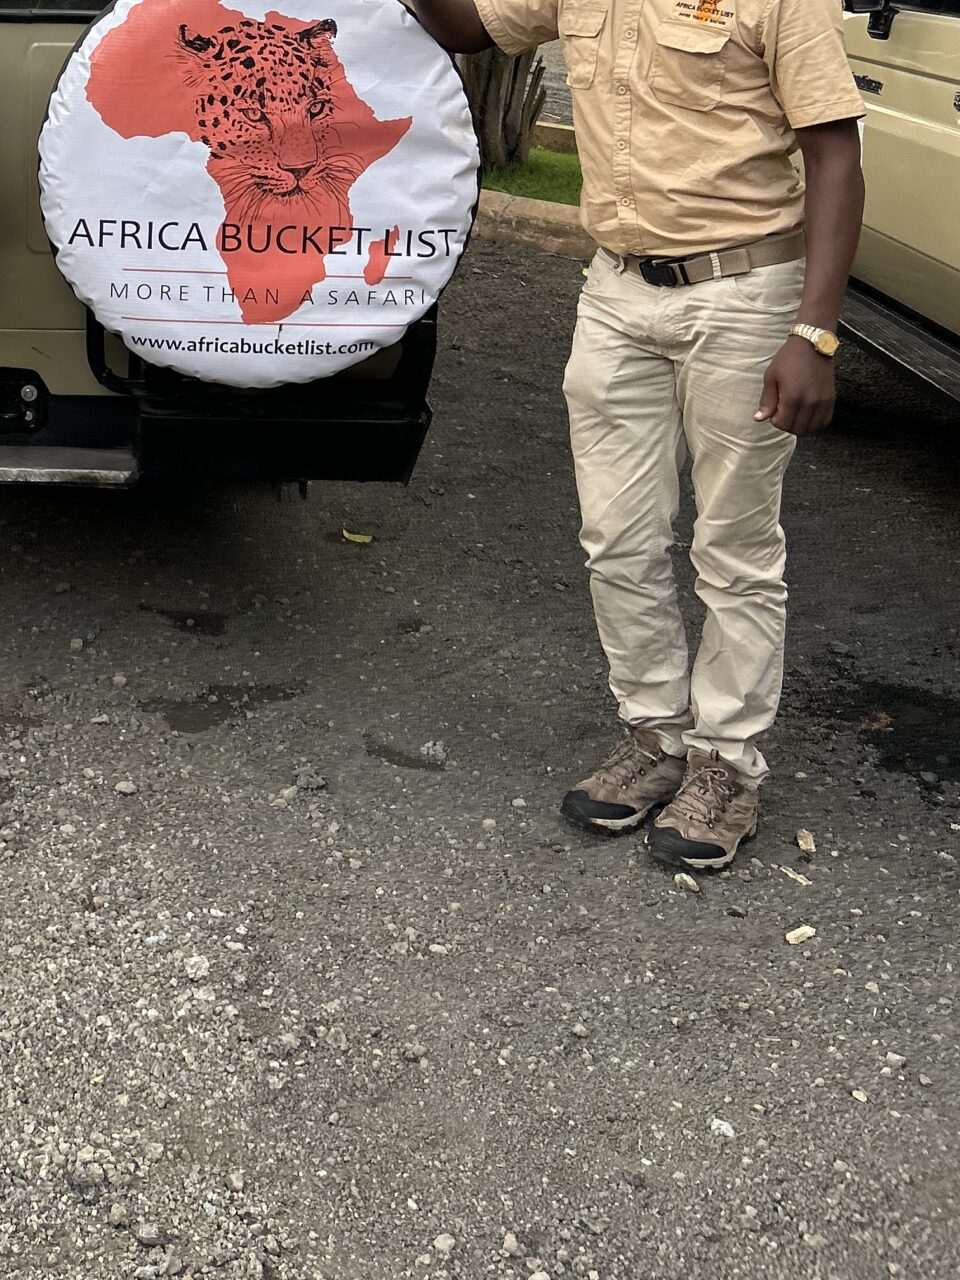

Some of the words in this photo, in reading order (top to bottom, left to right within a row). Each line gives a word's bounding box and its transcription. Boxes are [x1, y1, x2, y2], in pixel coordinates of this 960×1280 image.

[676, 2, 695, 10] AFRICA
[721, 10, 734, 18] LIST
[68, 218, 208, 251] AFRICA
[221, 223, 372, 255] BUCKET
[384, 228, 457, 257] LIST
[109, 282, 190, 301] MORE
[203, 286, 279, 305] THAN
[299, 290, 314, 305] A
[327, 289, 425, 305] SAFARI
[131, 334, 374, 355] www.africabucketlist.com
